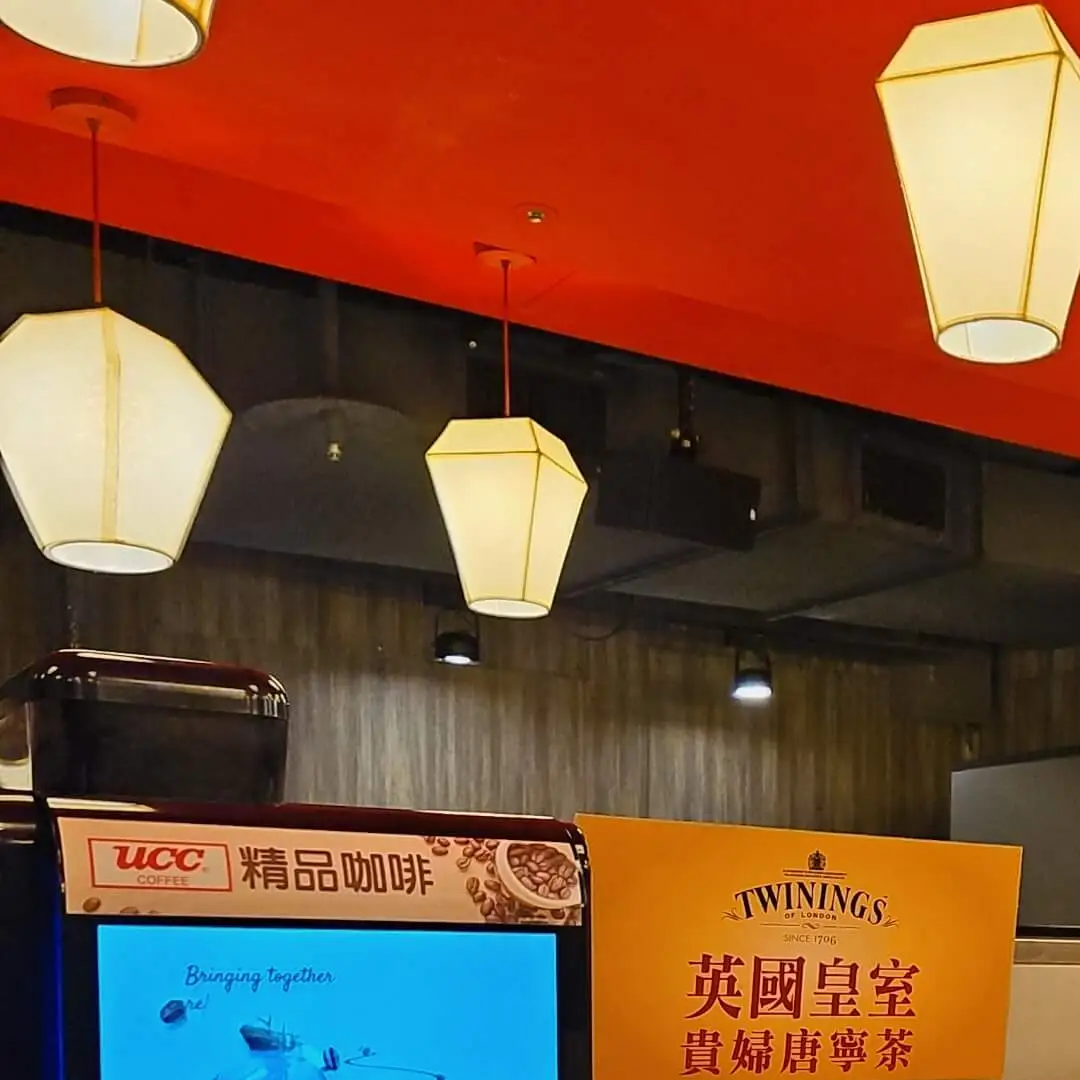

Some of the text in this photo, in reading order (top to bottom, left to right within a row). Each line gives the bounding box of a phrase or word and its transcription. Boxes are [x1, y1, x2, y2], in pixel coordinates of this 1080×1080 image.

[113, 845, 205, 872] UCC
[239, 846, 434, 895] 精品咖啡
[137, 874, 189, 886] COFFEE
[735, 881, 888, 925] TWININGS
[801, 913, 837, 921] LONDON
[783, 934, 837, 945] SINCE 1706
[185, 965, 336, 992] Bringing together
[684, 953, 921, 1020] 英國皇室
[679, 1027, 914, 1076] 貴婦唐寧茶
